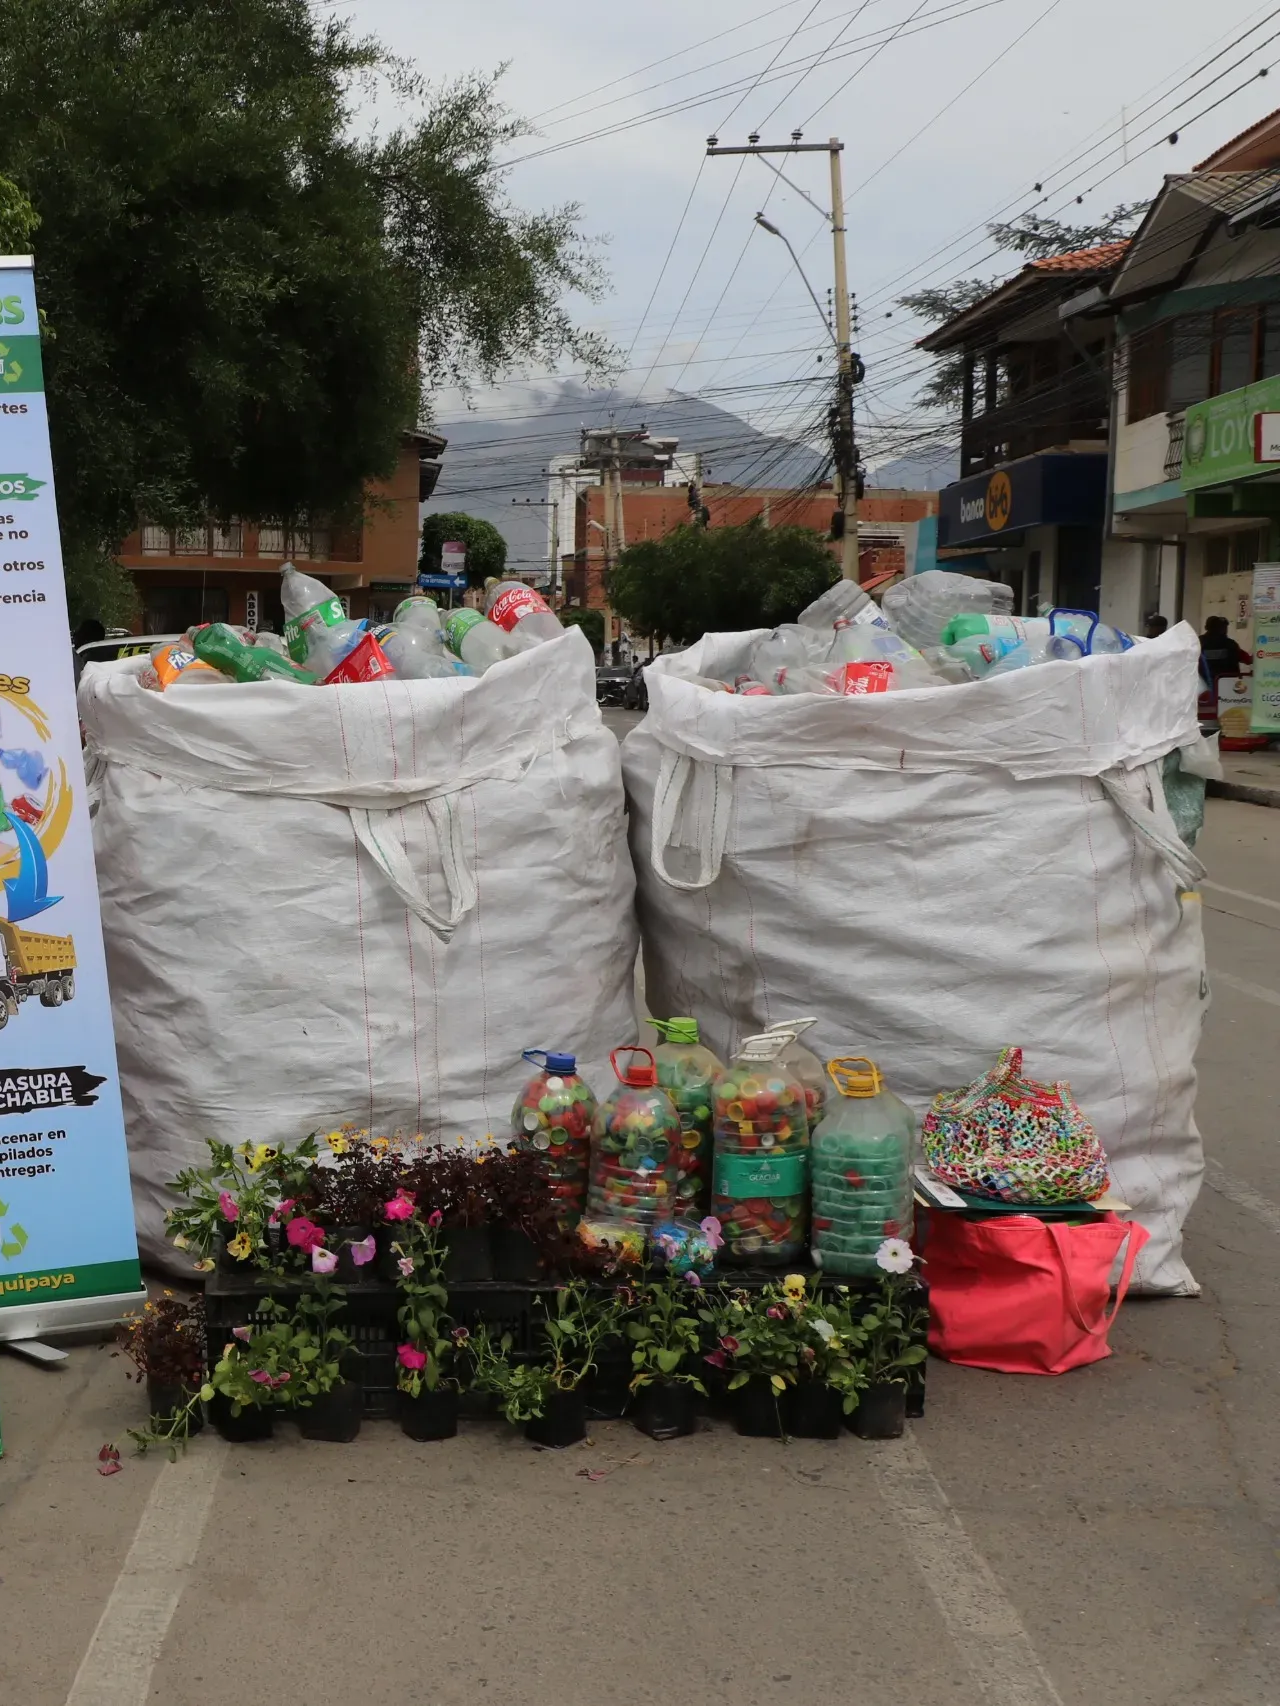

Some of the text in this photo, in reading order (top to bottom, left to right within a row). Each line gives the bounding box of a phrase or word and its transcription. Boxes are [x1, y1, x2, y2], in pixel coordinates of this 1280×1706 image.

[961, 497, 984, 523] banco
[8, 529, 29, 540] no
[3, 559, 45, 572] otros
[47, 1129, 66, 1139] en
